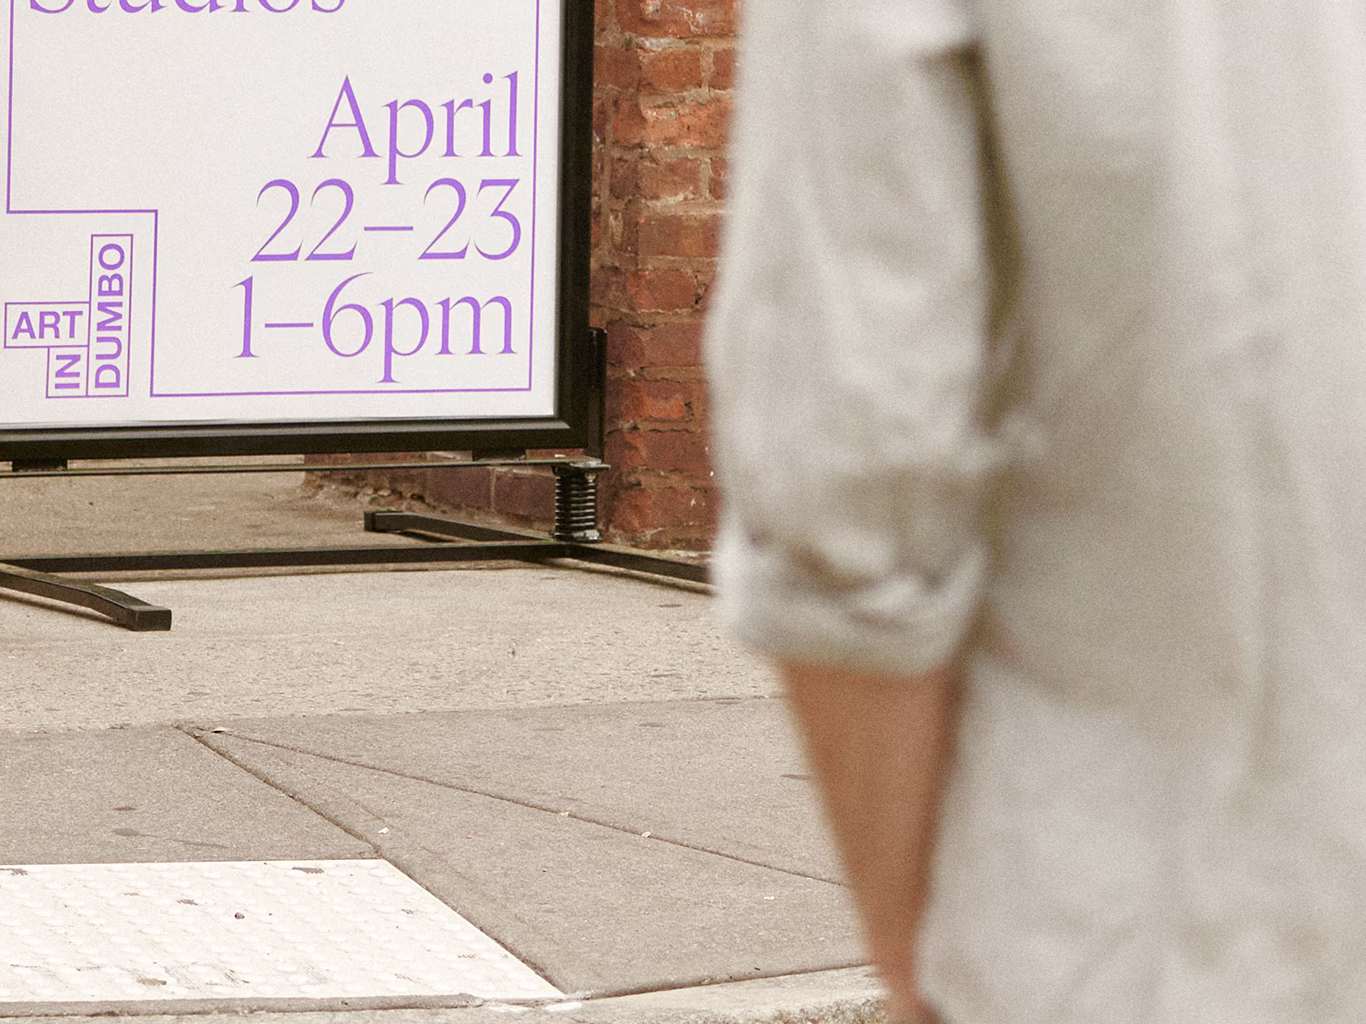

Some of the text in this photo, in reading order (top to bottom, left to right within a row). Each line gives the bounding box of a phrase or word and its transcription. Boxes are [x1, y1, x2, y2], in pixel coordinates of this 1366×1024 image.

[308, 70, 524, 186] April
[11, 310, 83, 340] ART
[94, 243, 125, 390] DUMBO
[54, 353, 81, 389] IN
